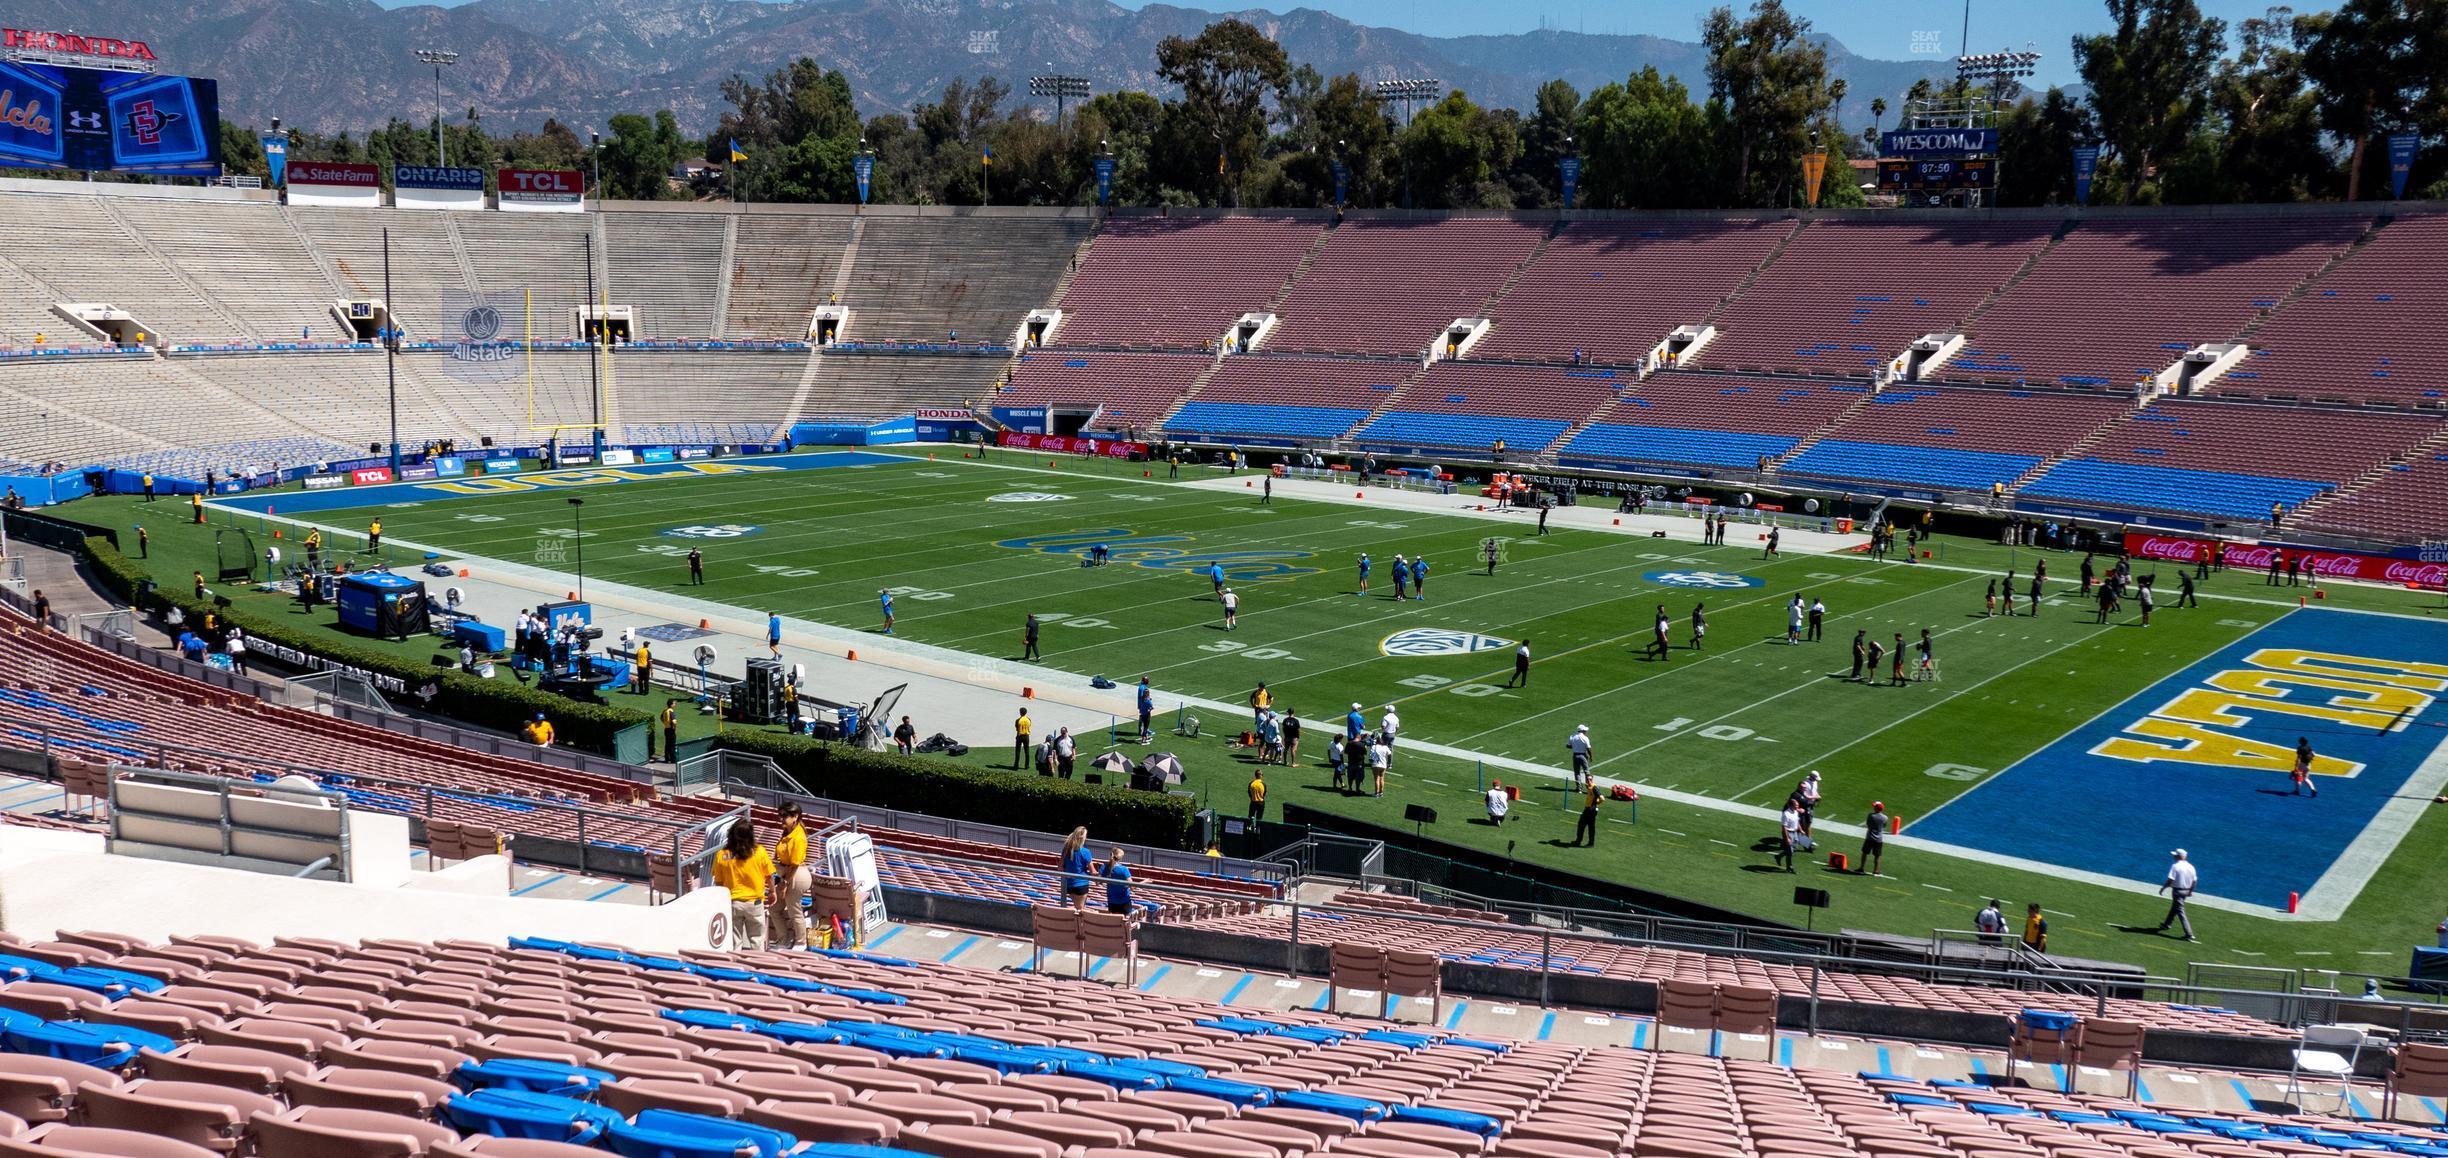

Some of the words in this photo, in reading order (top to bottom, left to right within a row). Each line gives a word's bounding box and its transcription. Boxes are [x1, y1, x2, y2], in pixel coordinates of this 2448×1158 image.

[3, 28, 158, 60] HONDA
[1891, 133, 1964, 151] WESCOM
[397, 167, 482, 184] ONTARIO
[1893, 173, 1900, 182] 0
[1921, 163, 1950, 174] 87:50
[1971, 171, 1978, 181] 0
[513, 172, 569, 191] TCL
[351, 303, 371, 317] 40
[451, 342, 513, 361] Allstate
[917, 409, 972, 419] HONDA
[305, 475, 344, 485] NISSAN
[358, 470, 388, 482] TCL
[412, 463, 787, 494] UCLA
[1617, 482, 1639, 491] ROSE
[1197, 640, 1292, 660] 30
[278, 646, 306, 665] FIELD
[306, 655, 320, 669] AT
[375, 673, 407, 694] BOWL
[1394, 674, 1504, 698] 20
[2087, 648, 2448, 779] UCLA
[1652, 717, 1756, 741] 10
[1923, 763, 1989, 781] G
[712, 916, 724, 939] 21
